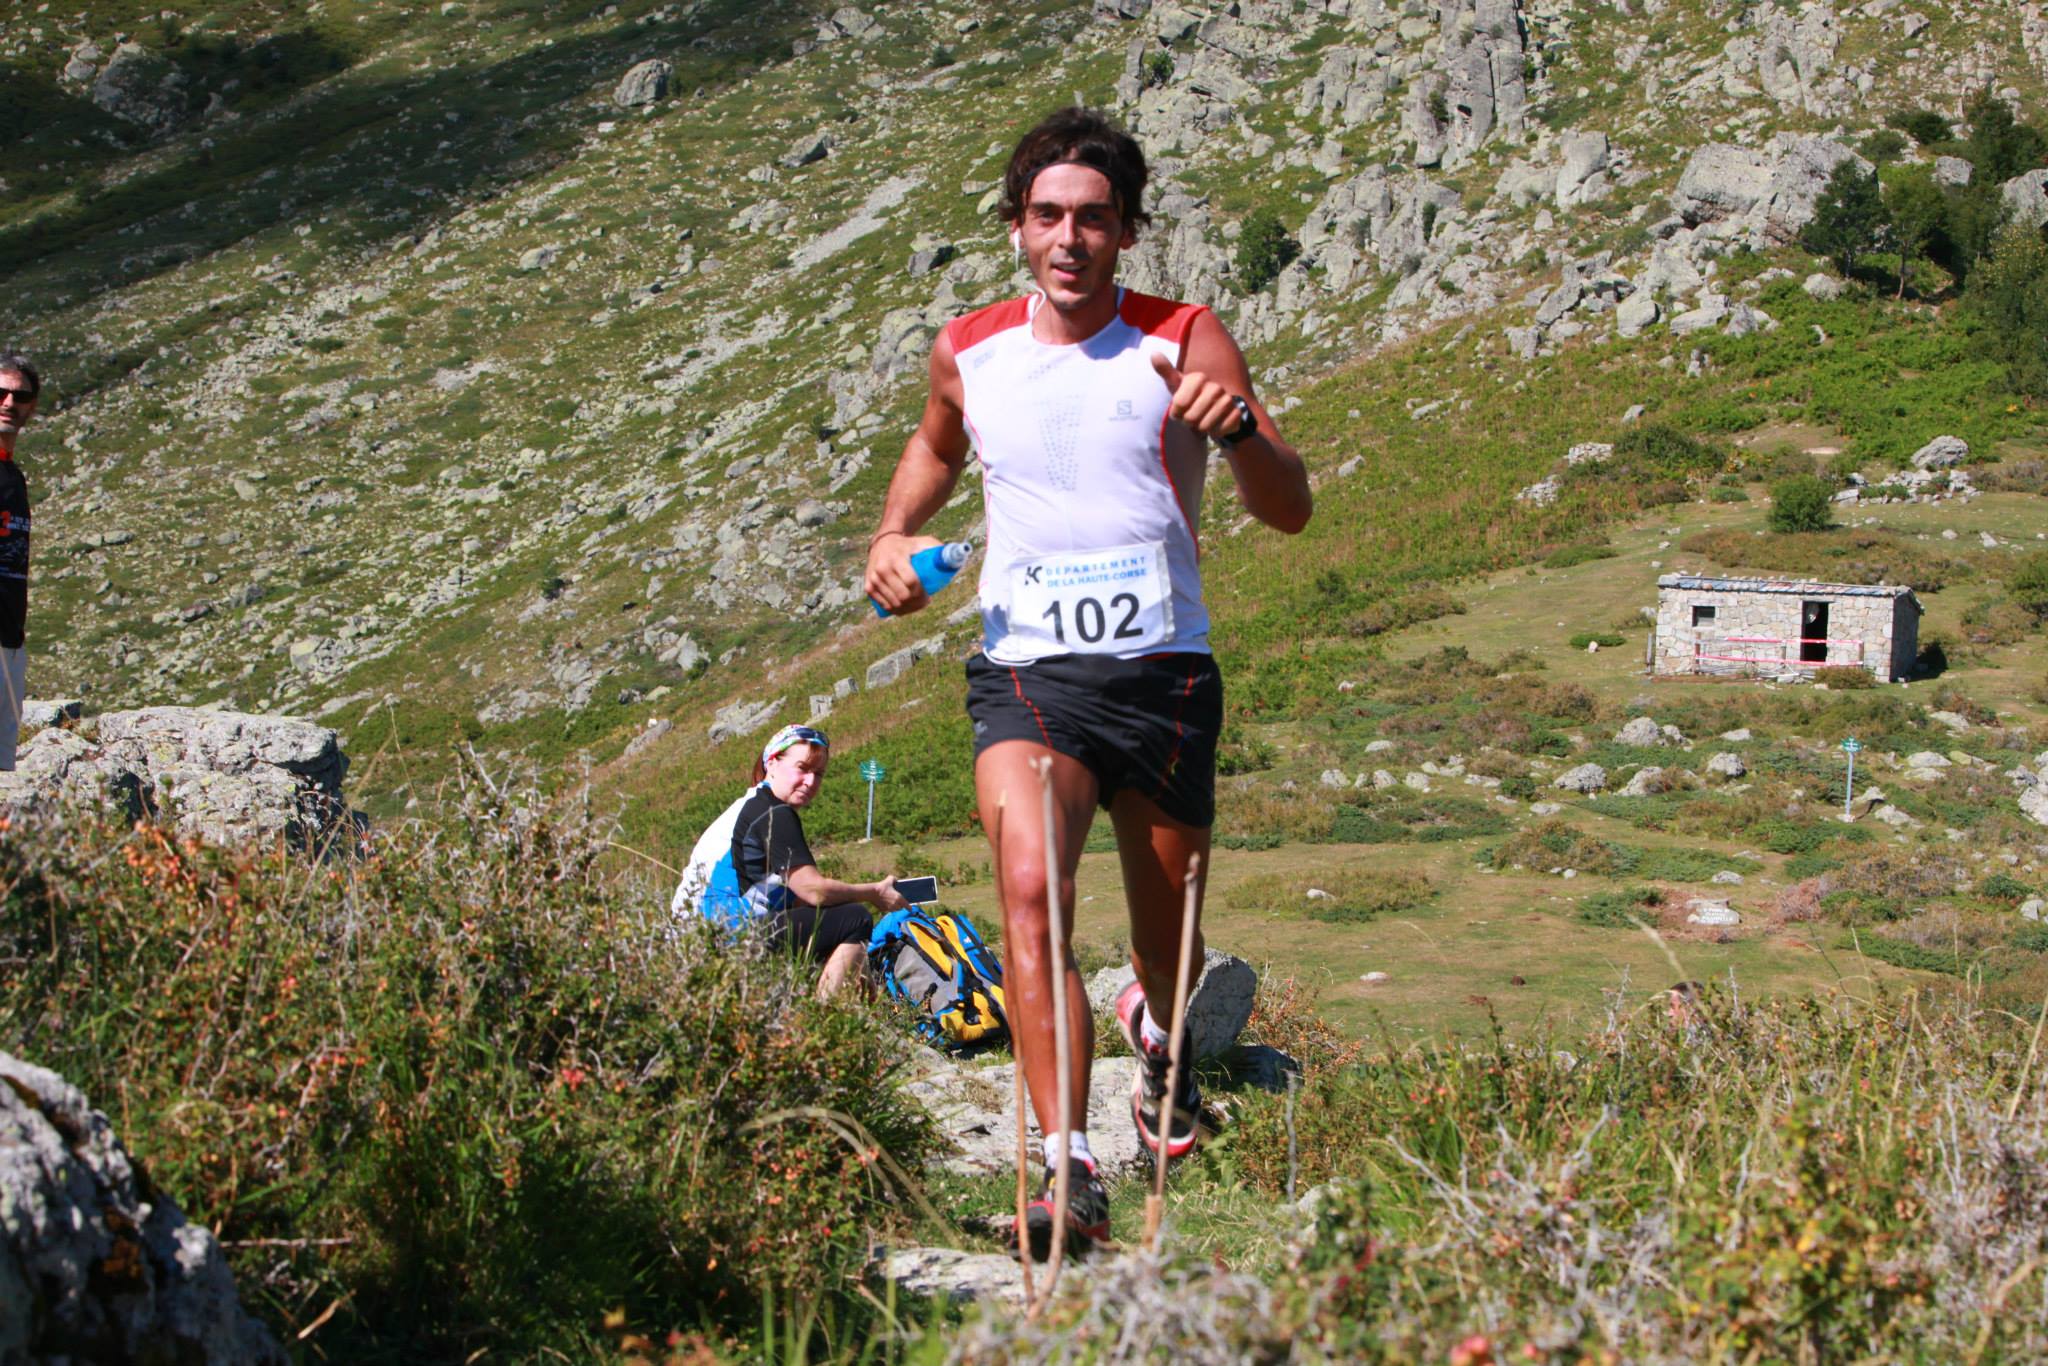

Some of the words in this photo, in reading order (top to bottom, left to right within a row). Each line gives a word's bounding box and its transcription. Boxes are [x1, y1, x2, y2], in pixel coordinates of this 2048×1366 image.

[1047, 579, 1059, 588] DE
[1062, 577, 1075, 586] LA
[1078, 567, 1147, 585] HAUTE-CORSE
[1042, 592, 1143, 644] 102
